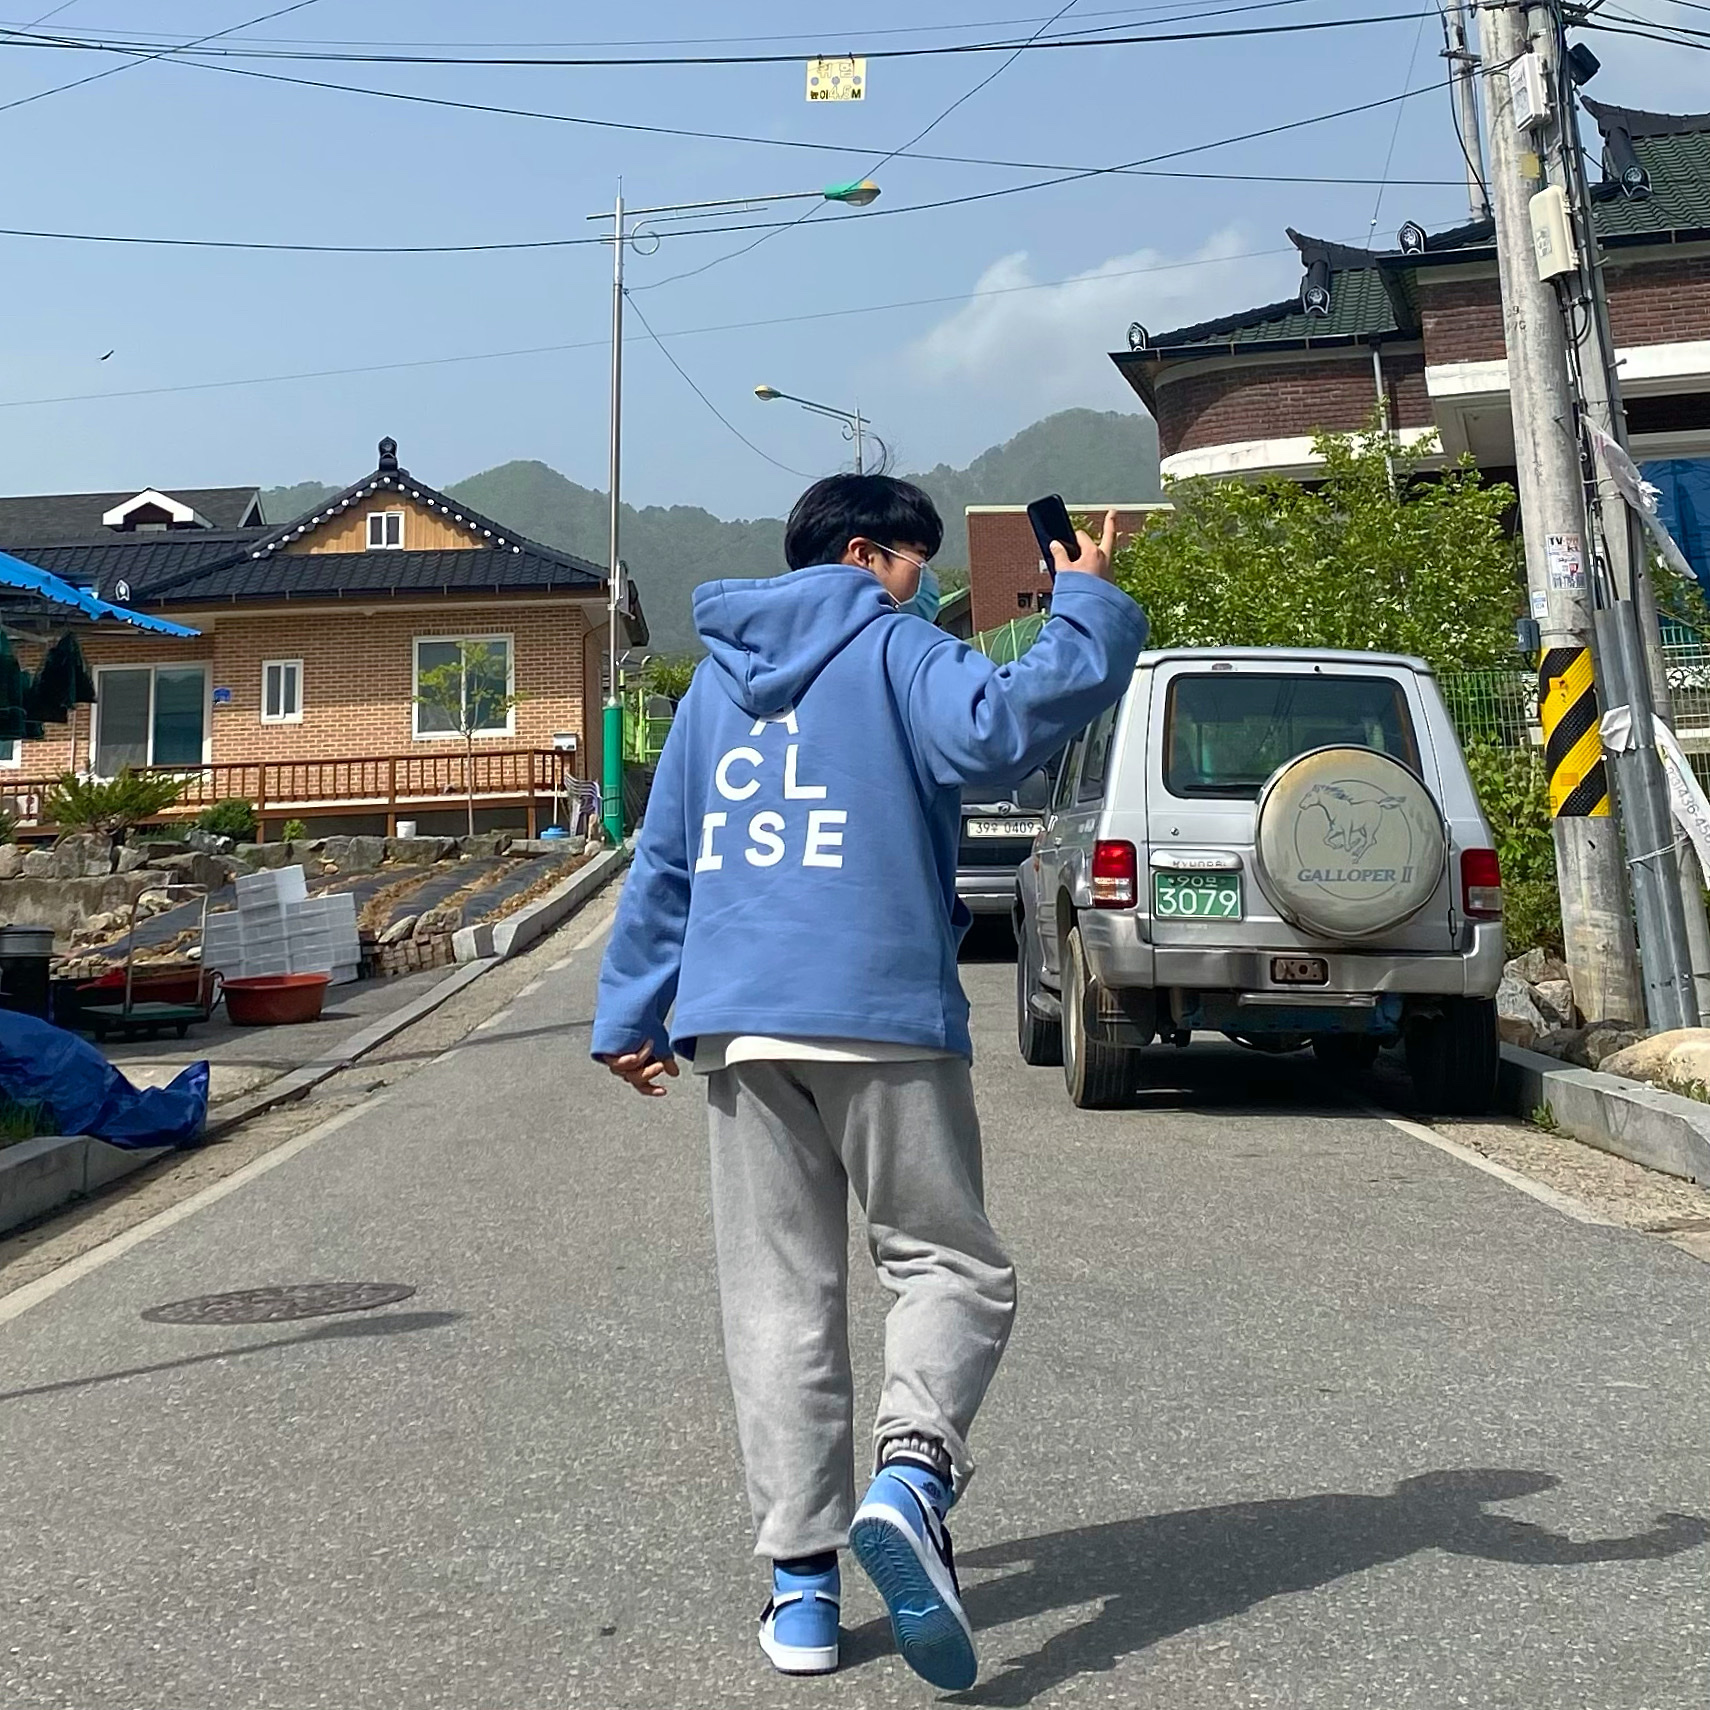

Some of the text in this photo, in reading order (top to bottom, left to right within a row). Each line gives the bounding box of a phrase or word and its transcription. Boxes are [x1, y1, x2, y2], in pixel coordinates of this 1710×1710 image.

[1004, 821, 1034, 834] 0409
[695, 810, 847, 874] ISE
[1297, 868, 1396, 883] GALLOPER
[1158, 887, 1237, 916] 3079
